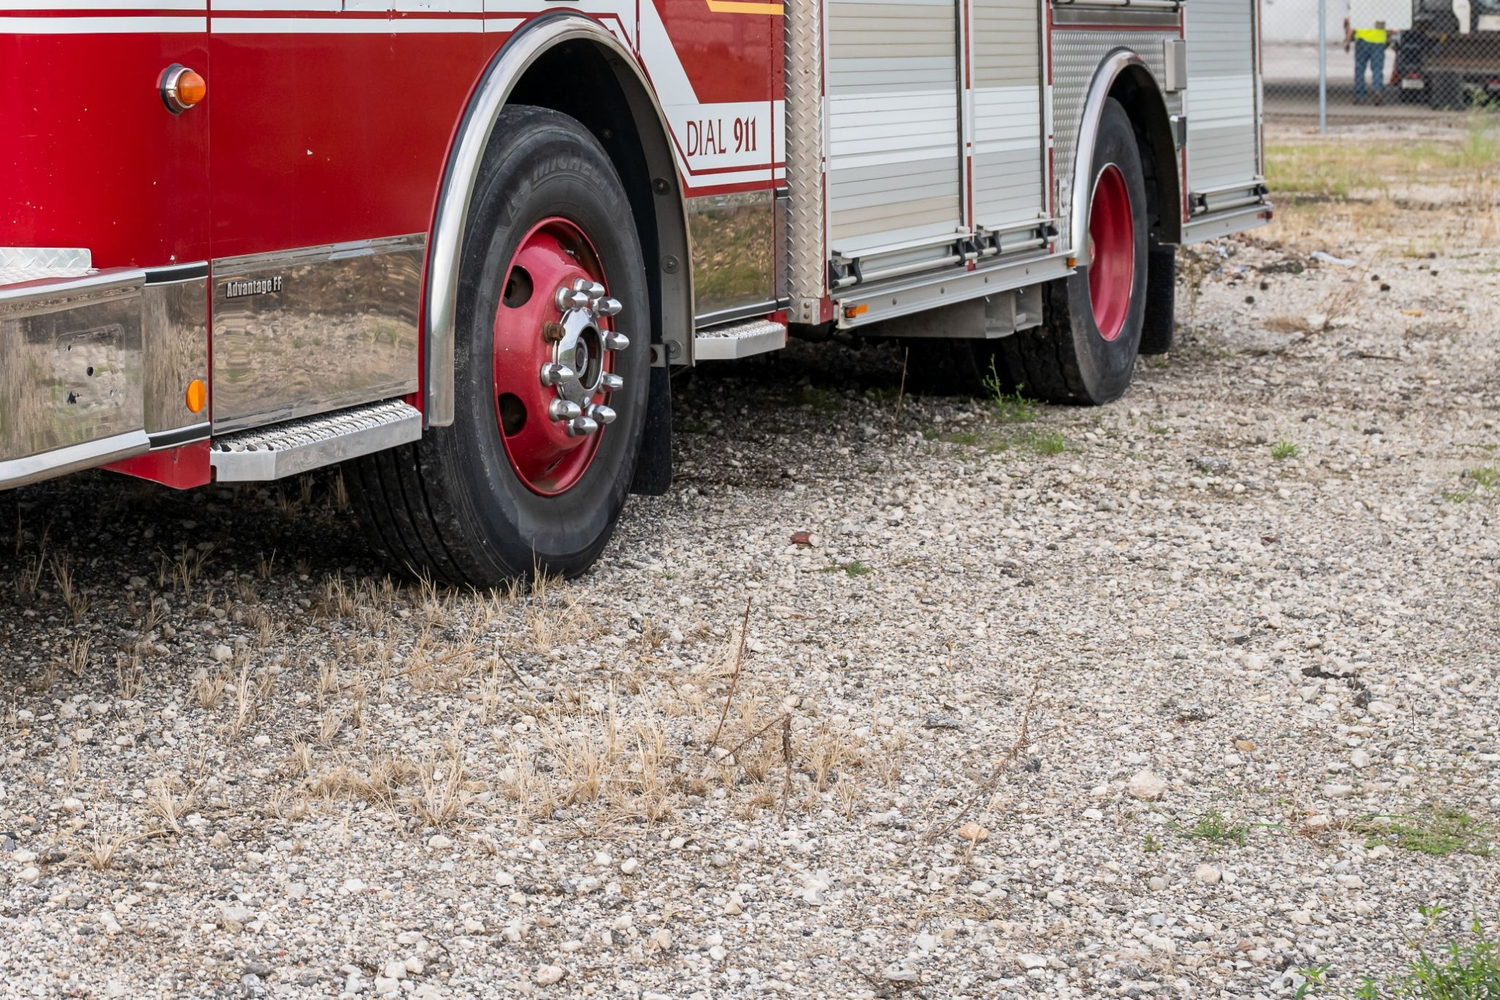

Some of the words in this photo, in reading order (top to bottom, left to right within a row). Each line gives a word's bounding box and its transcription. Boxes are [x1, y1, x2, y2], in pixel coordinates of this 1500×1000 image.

[686, 119, 727, 157] DIAL
[733, 116, 757, 154] 911
[227, 280, 272, 297] Advantage
[273, 276, 282, 291] FF
